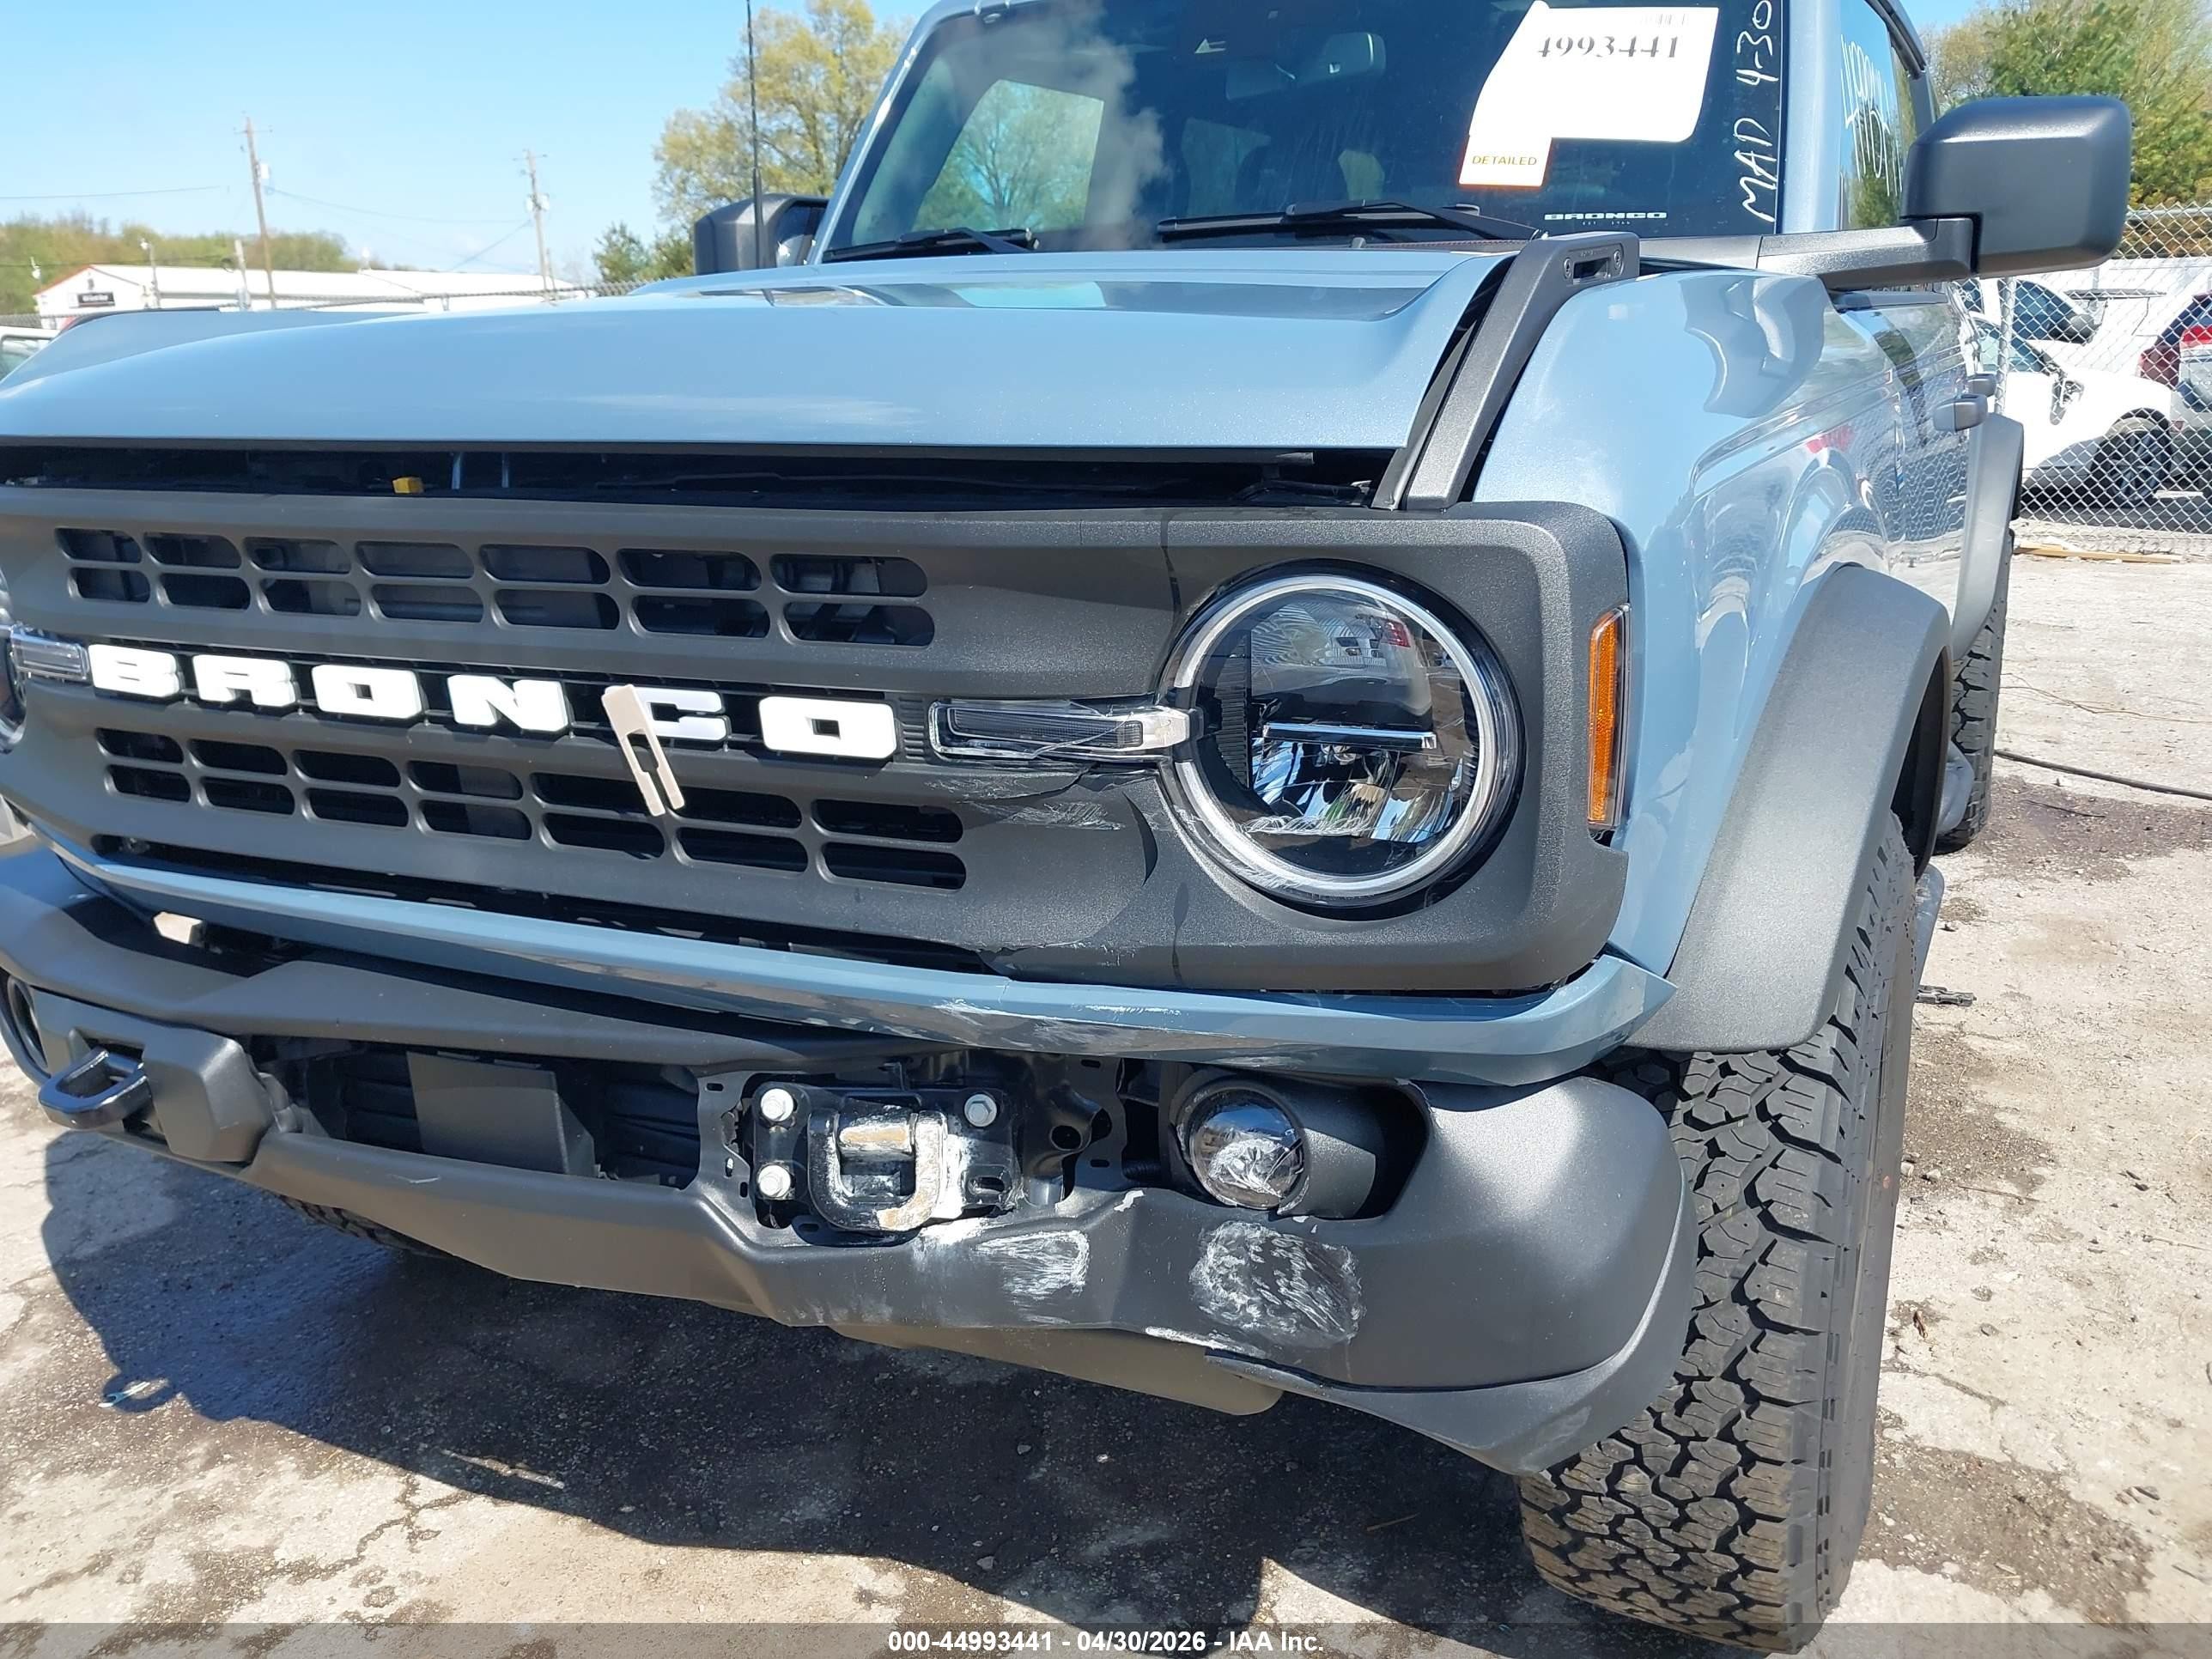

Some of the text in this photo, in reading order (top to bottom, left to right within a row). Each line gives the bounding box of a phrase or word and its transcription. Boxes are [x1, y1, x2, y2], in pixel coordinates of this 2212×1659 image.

[1472, 155, 1538, 167] DETAILED
[1733, 117, 1778, 223] MAD
[1544, 212, 1668, 221] BRONCO
[88, 644, 897, 759] BRONCO
